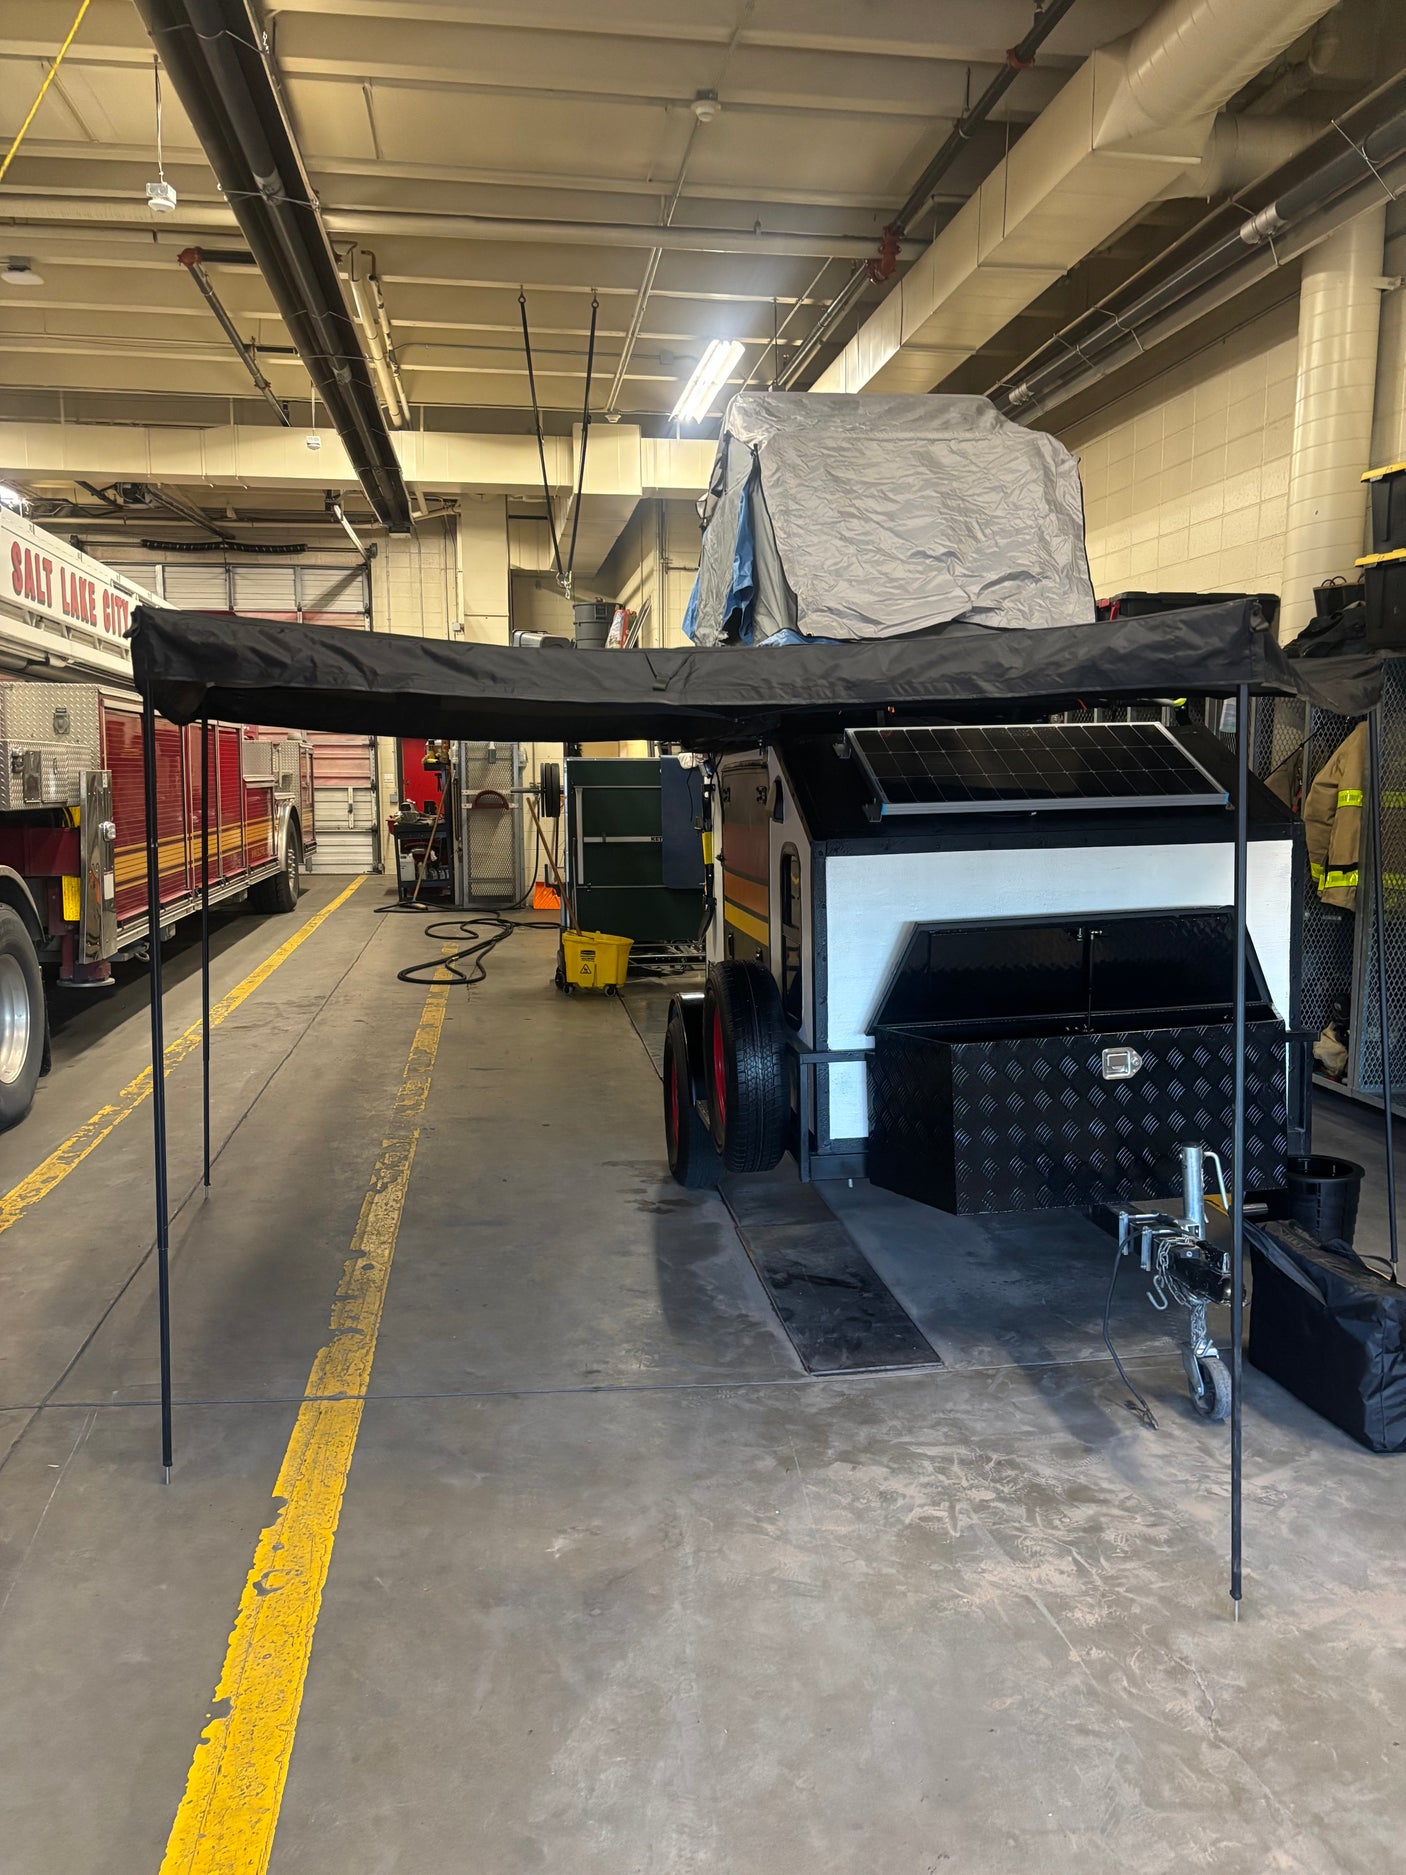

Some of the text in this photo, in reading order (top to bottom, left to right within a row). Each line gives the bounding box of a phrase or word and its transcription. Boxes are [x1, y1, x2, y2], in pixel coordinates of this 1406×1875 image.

[11, 541, 129, 637] SALT LAKE CITY
